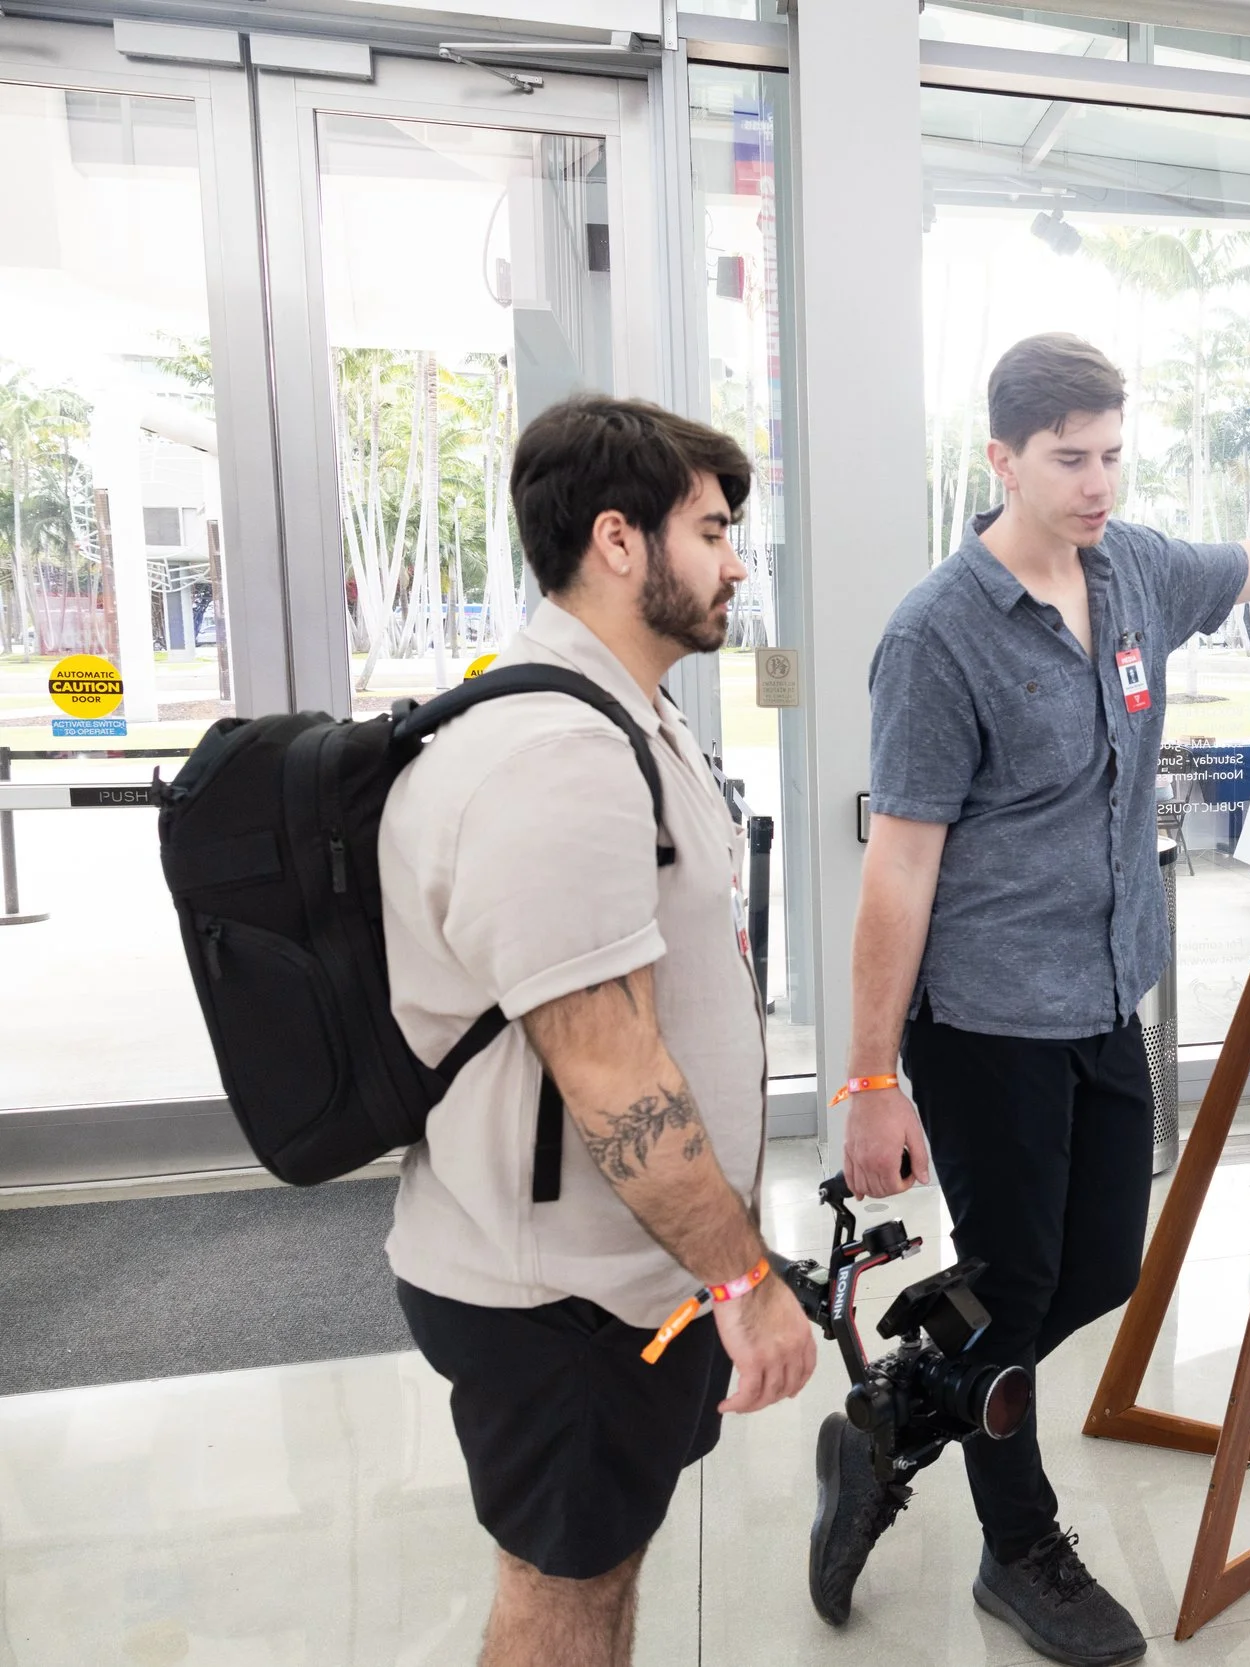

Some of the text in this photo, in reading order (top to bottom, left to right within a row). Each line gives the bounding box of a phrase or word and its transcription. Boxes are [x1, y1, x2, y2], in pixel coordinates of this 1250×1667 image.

[57, 671, 115, 679] AUTOMATIC
[52, 682, 120, 693] CAUTION
[53, 720, 125, 728] ACTIVATE SWITCH
[99, 791, 148, 802] PUSH
[833, 1270, 849, 1320] RONIN
